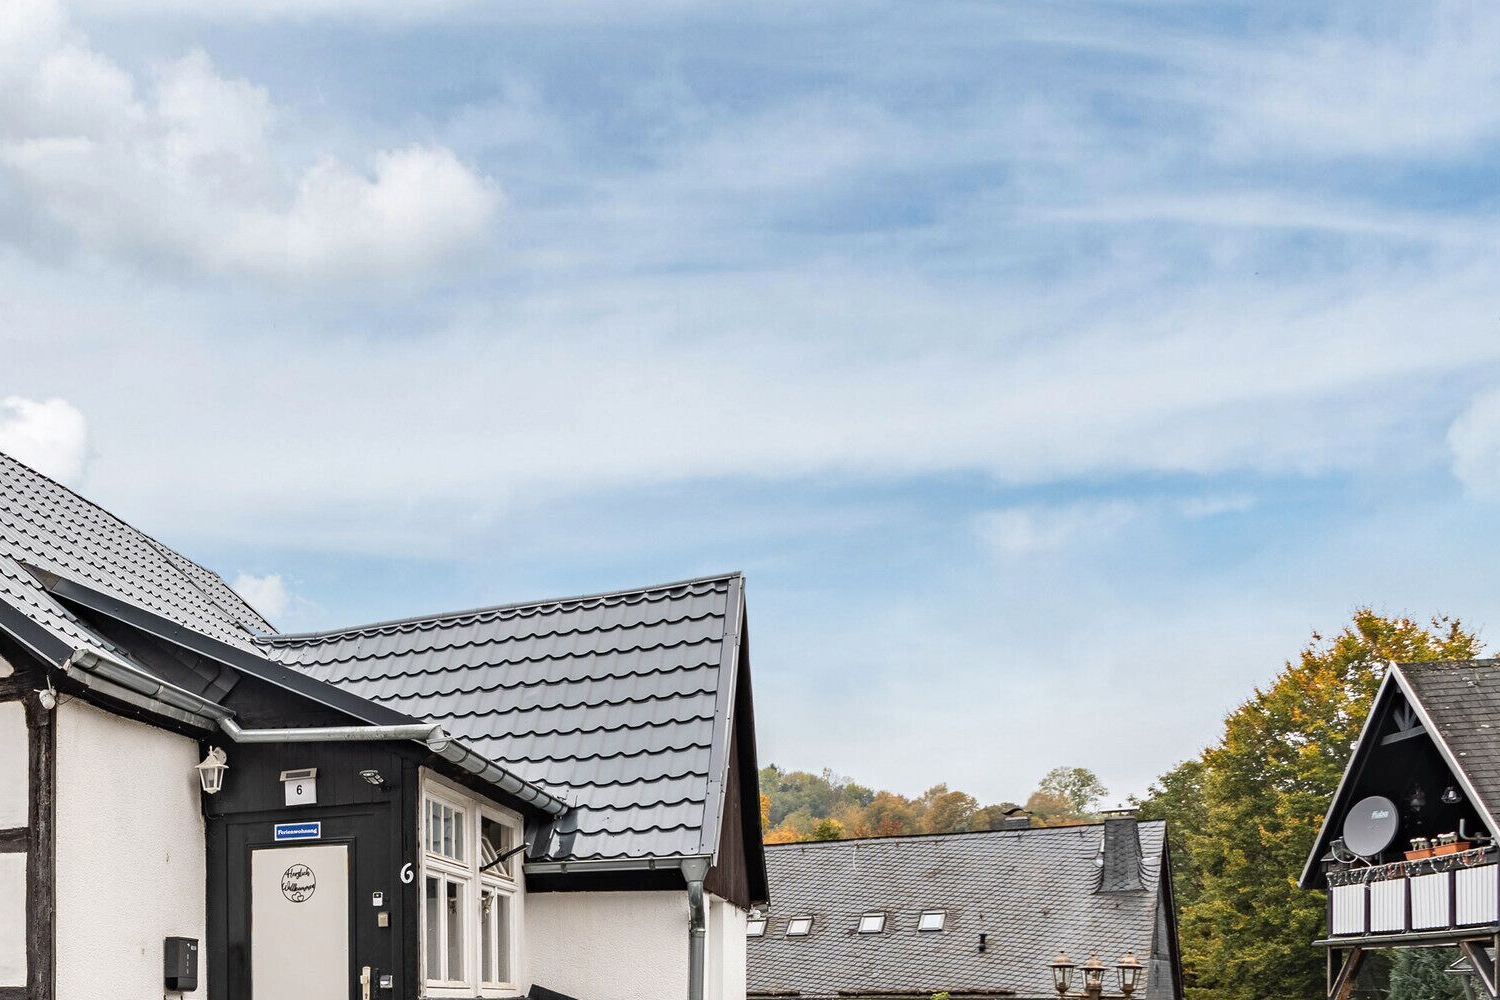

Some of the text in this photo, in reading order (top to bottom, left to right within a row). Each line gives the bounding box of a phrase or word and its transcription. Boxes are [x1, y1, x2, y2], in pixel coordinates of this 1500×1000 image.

[296, 784, 303, 795] 6
[284, 867, 311, 880] Herzlich
[400, 862, 414, 884] 6
[281, 881, 315, 892] Willkommen
